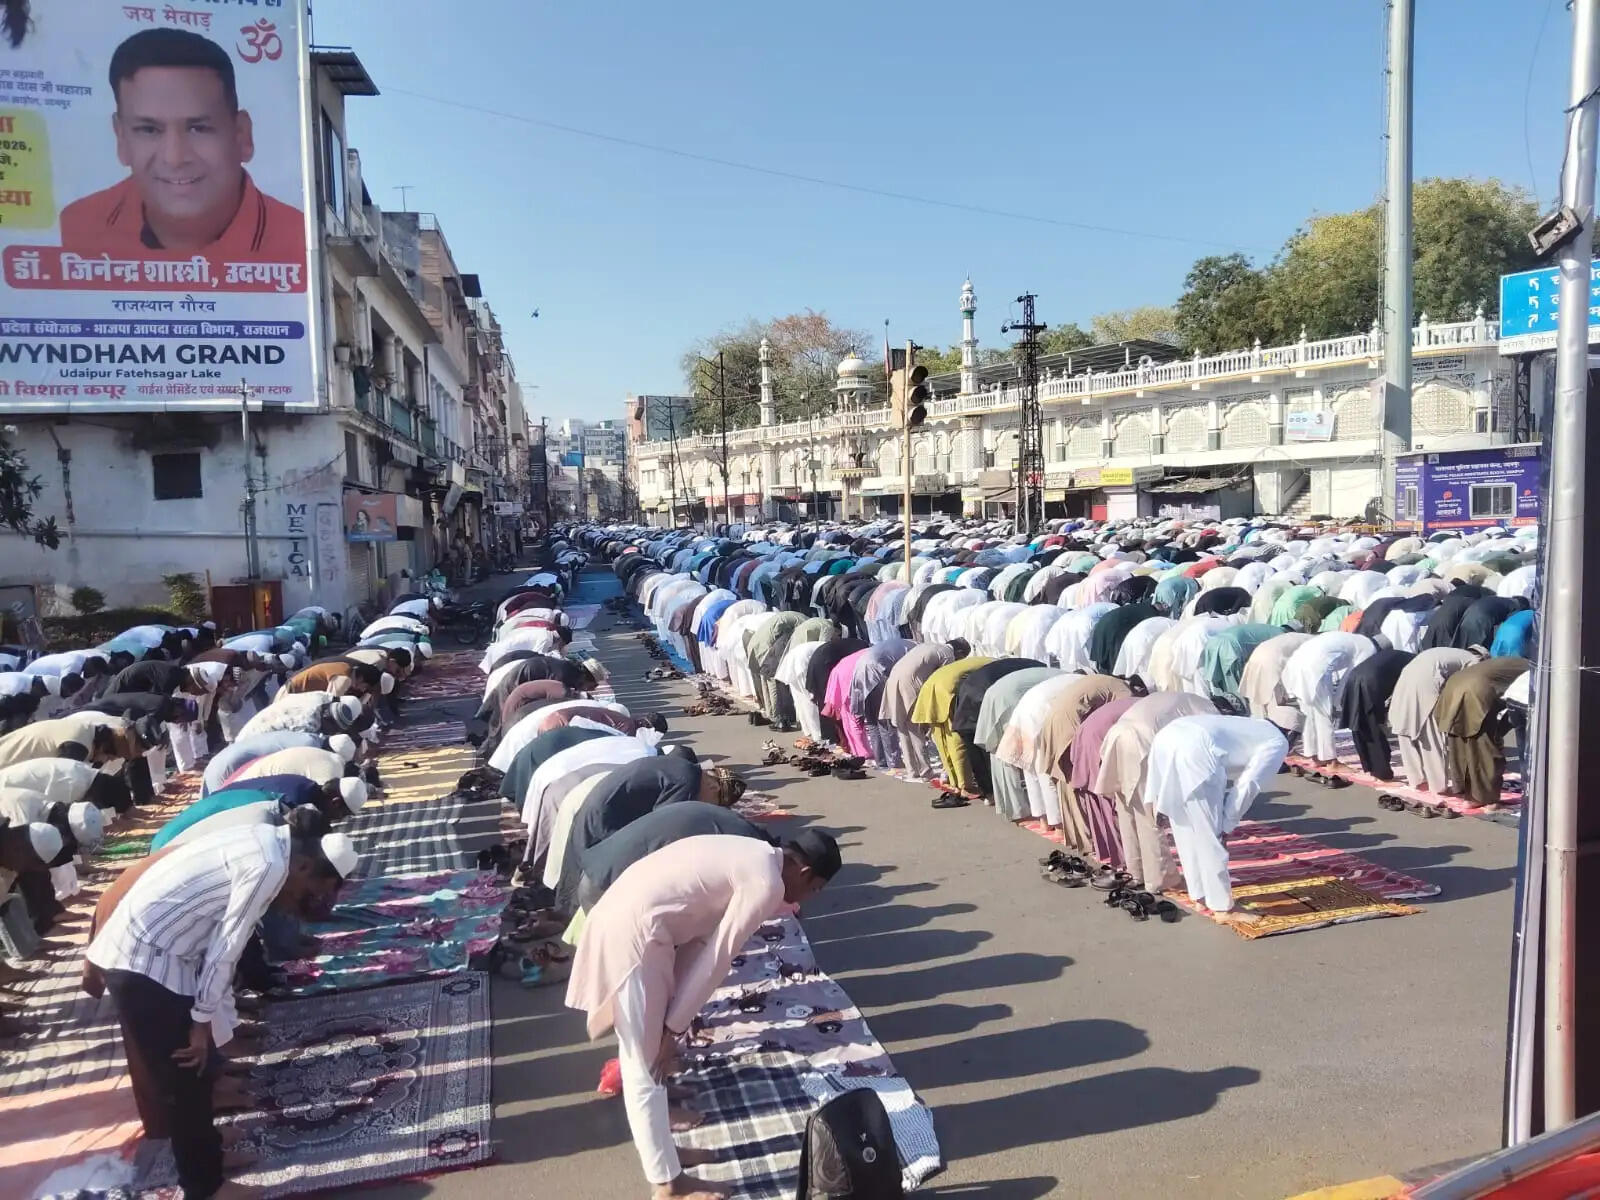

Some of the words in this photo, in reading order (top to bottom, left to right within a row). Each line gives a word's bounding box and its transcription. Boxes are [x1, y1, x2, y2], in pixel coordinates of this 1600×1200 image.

[122, 6, 155, 22] जय
[163, 4, 213, 32] मेवाड़
[16, 81, 37, 92] दास
[40, 80, 53, 93] जी
[55, 84, 92, 96] महाराज
[0, 140, 32, 152] 026,
[12, 250, 51, 280] डॉ.
[60, 252, 140, 283] जिनेन्द्र
[143, 255, 219, 288] शास्त्री,
[223, 262, 302, 292] उदयपुर
[111, 300, 173, 312] राजस्थान
[179, 293, 216, 312] गौरव
[34, 321, 82, 335] संयोजक
[94, 324, 131, 335] भाजपा
[133, 324, 169, 335] आपदा
[172, 324, 198, 335] राहत
[201, 322, 239, 337] विभाग,
[242, 325, 290, 336] राजस्थान
[0, 343, 166, 364] WYNDHAM
[176, 344, 286, 365] GRAND
[60, 368, 112, 380] Udaipur
[116, 368, 188, 381] Fatehsagar
[191, 369, 222, 379] Lake
[14, 380, 79, 396] विशाल
[82, 384, 127, 399] कपूर
